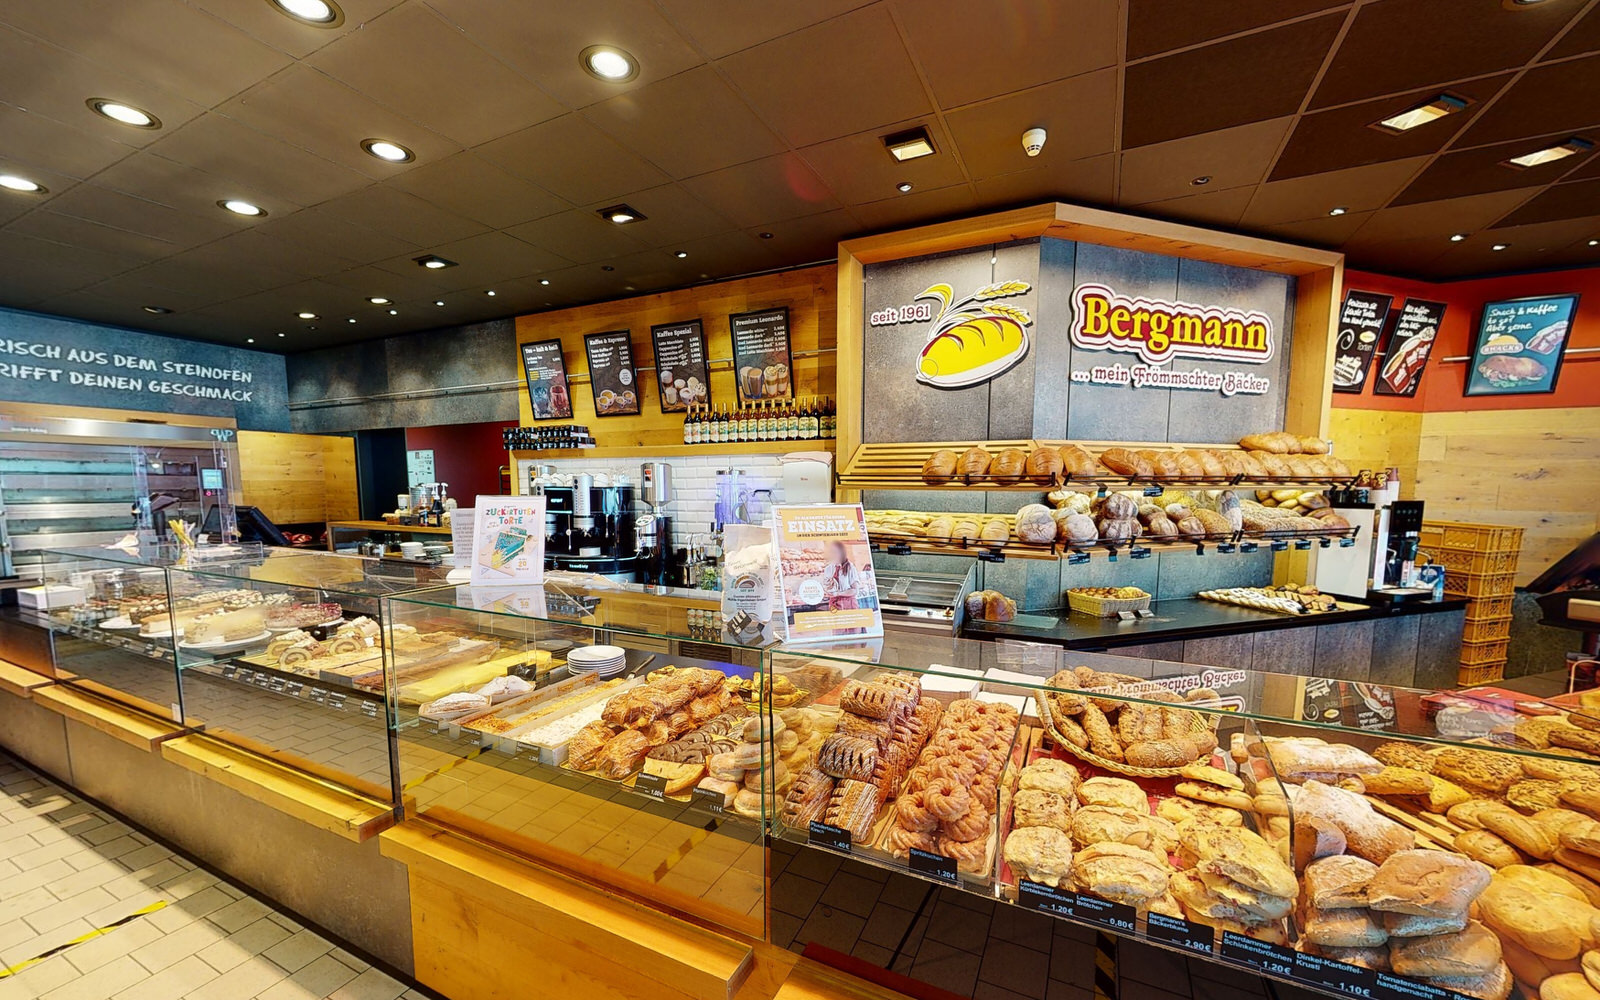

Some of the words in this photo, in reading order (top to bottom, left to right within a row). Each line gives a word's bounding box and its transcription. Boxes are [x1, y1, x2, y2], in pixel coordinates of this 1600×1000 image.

[872, 310, 897, 323] seit
[901, 306, 930, 320] 1961
[1489, 307, 1516, 317] Snack
[1517, 307, 1525, 315] &
[1526, 304, 1559, 316] Kaffee
[736, 317, 759, 326] Premium
[759, 314, 784, 323] Leonardo
[1082, 296, 1267, 352] Bergmann
[1487, 317, 1497, 325] to
[1498, 314, 1515, 326] go?
[656, 330, 673, 338] Kaffee
[673, 327, 692, 337] Spezial
[1485, 324, 1506, 333] Aber
[1507, 323, 1533, 334] gerne
[67, 347, 109, 365] AUS
[113, 353, 158, 371] DEM
[162, 360, 253, 383] STEINOFEN
[69, 370, 143, 391] DEINEN
[148, 379, 254, 402] GESCHMACK
[1094, 366, 1129, 381] mein
[1133, 366, 1221, 388] Frömmschter
[1225, 373, 1269, 392] Bäcker
[499, 516, 524, 525] TORTE
[786, 519, 856, 533] EINSATZ
[1020, 880, 1055, 894] Leerdammer
[1076, 893, 1114, 909] Leerdammer
[1076, 899, 1104, 912] Brötchen
[1223, 931, 1273, 950] Leerdammer
[1222, 937, 1293, 964] Schinkenbrötchen
[1295, 951, 1364, 975] Dinkel-Kartoffel-
[1295, 958, 1321, 972] Krusti
[1375, 978, 1434, 1000] handgemacht
[1376, 971, 1447, 997] Tomatenciabatta
